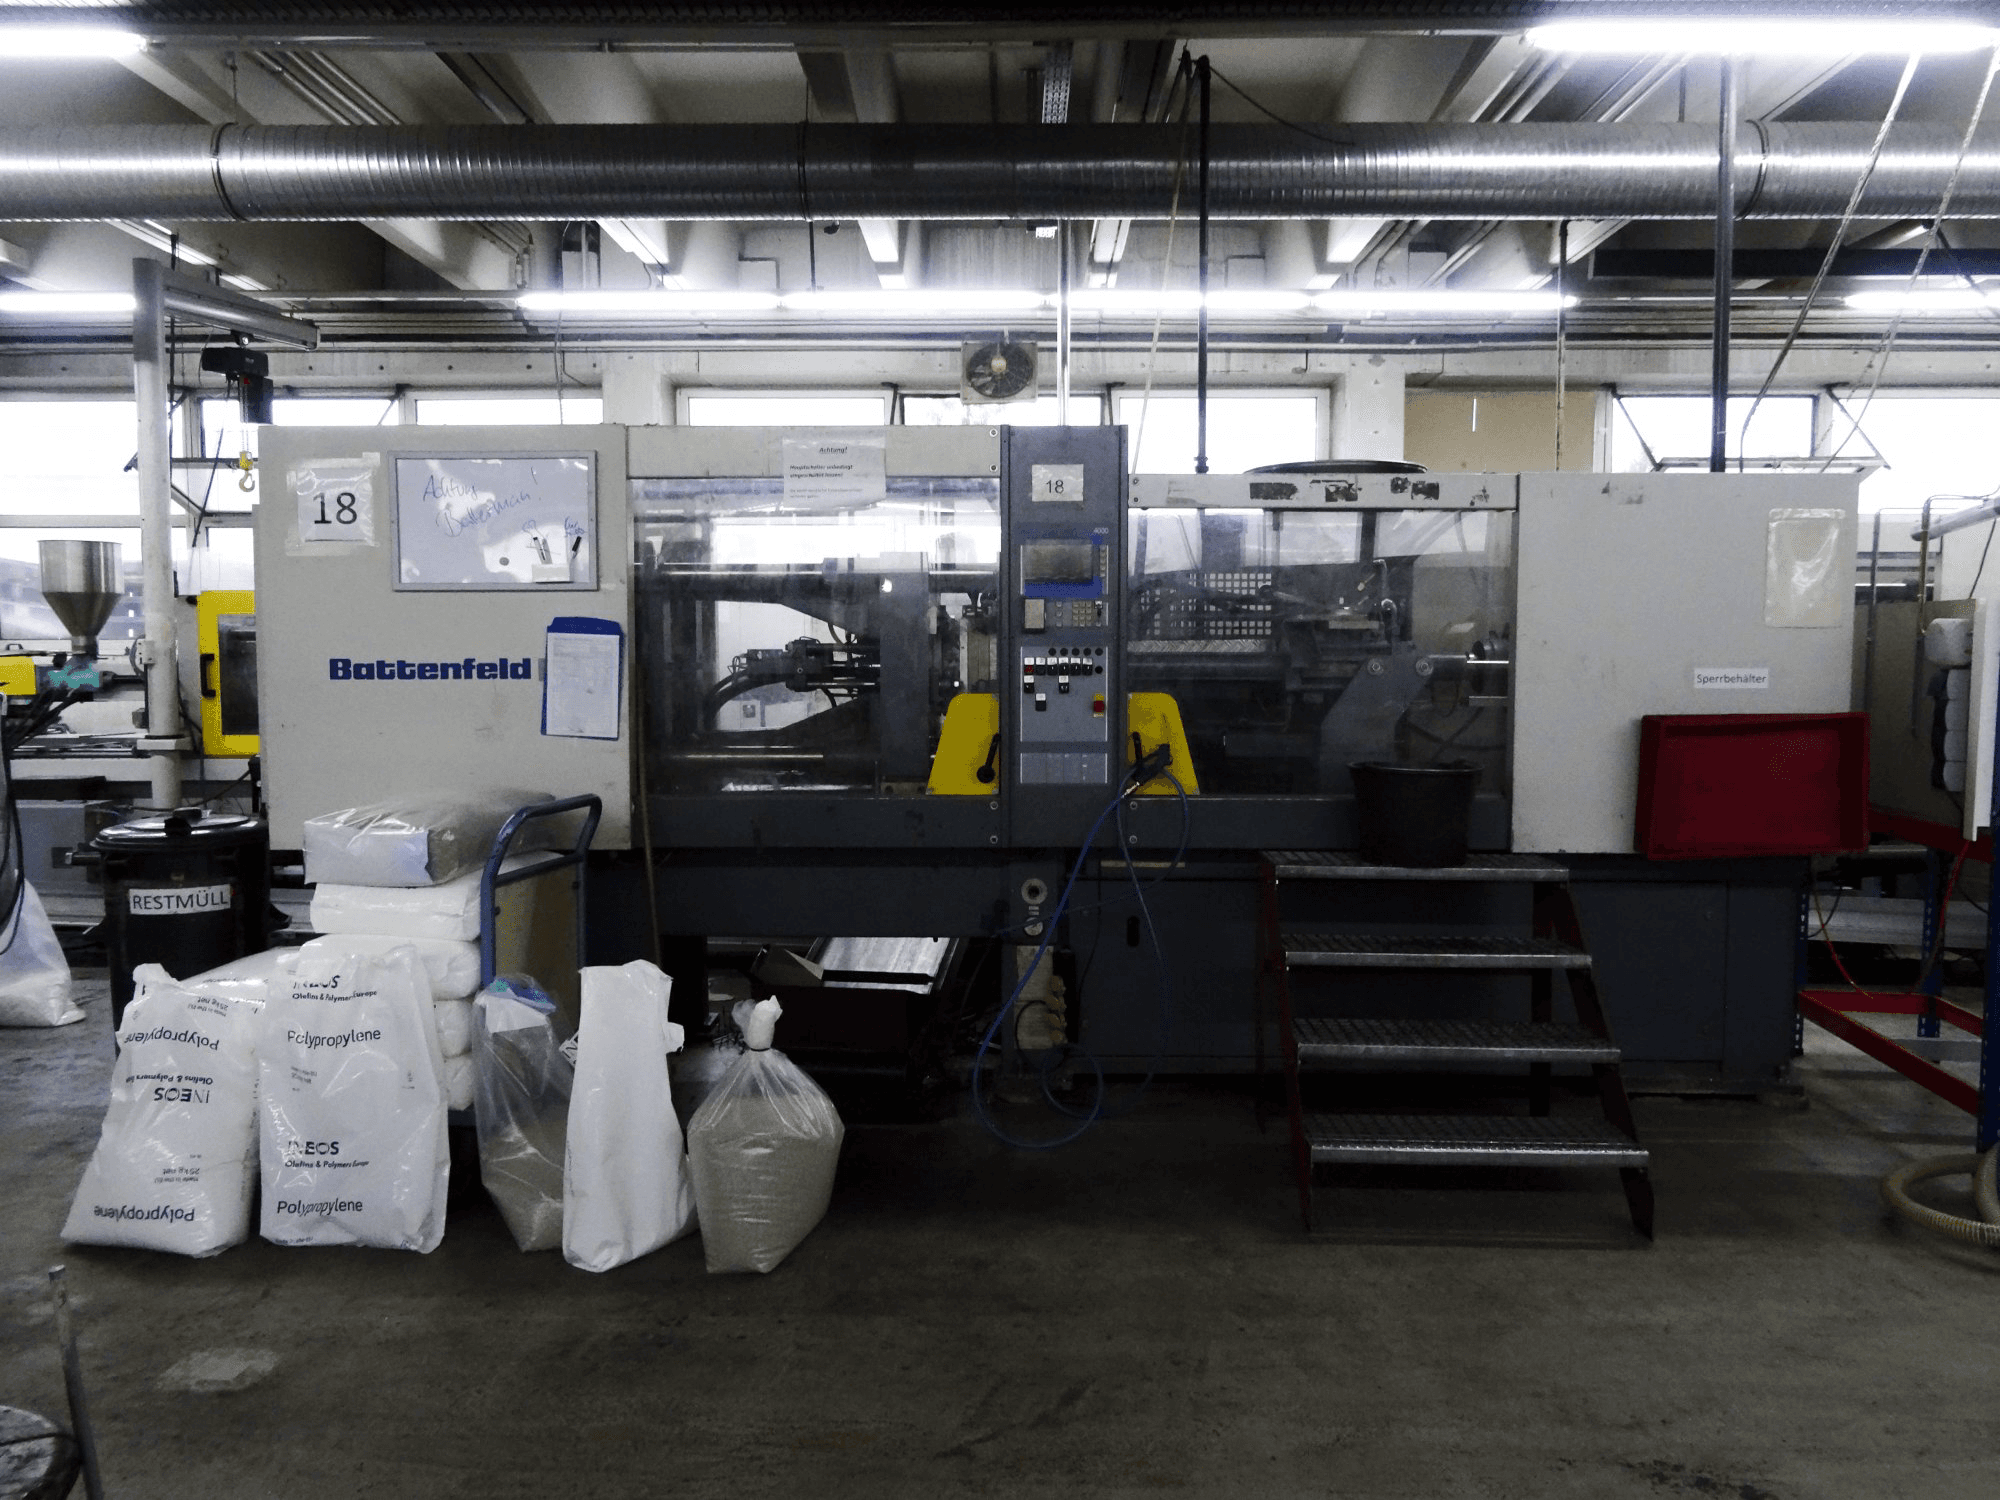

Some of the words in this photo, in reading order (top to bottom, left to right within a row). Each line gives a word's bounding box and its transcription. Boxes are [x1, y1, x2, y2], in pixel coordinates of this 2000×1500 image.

[1046, 480, 1065, 494] 18
[313, 492, 359, 525] 18
[329, 658, 532, 681] Battenfeld
[1696, 673, 1767, 685] Sperrbehälter
[132, 889, 228, 910] RESTMÜLL
[287, 1028, 382, 1050] Polypropylene
[184, 1075, 214, 1085] Olefins
[154, 1087, 211, 1104] INEOS
[93, 1205, 195, 1224] Polypropylene
[276, 1197, 364, 1217] Polypropylene
